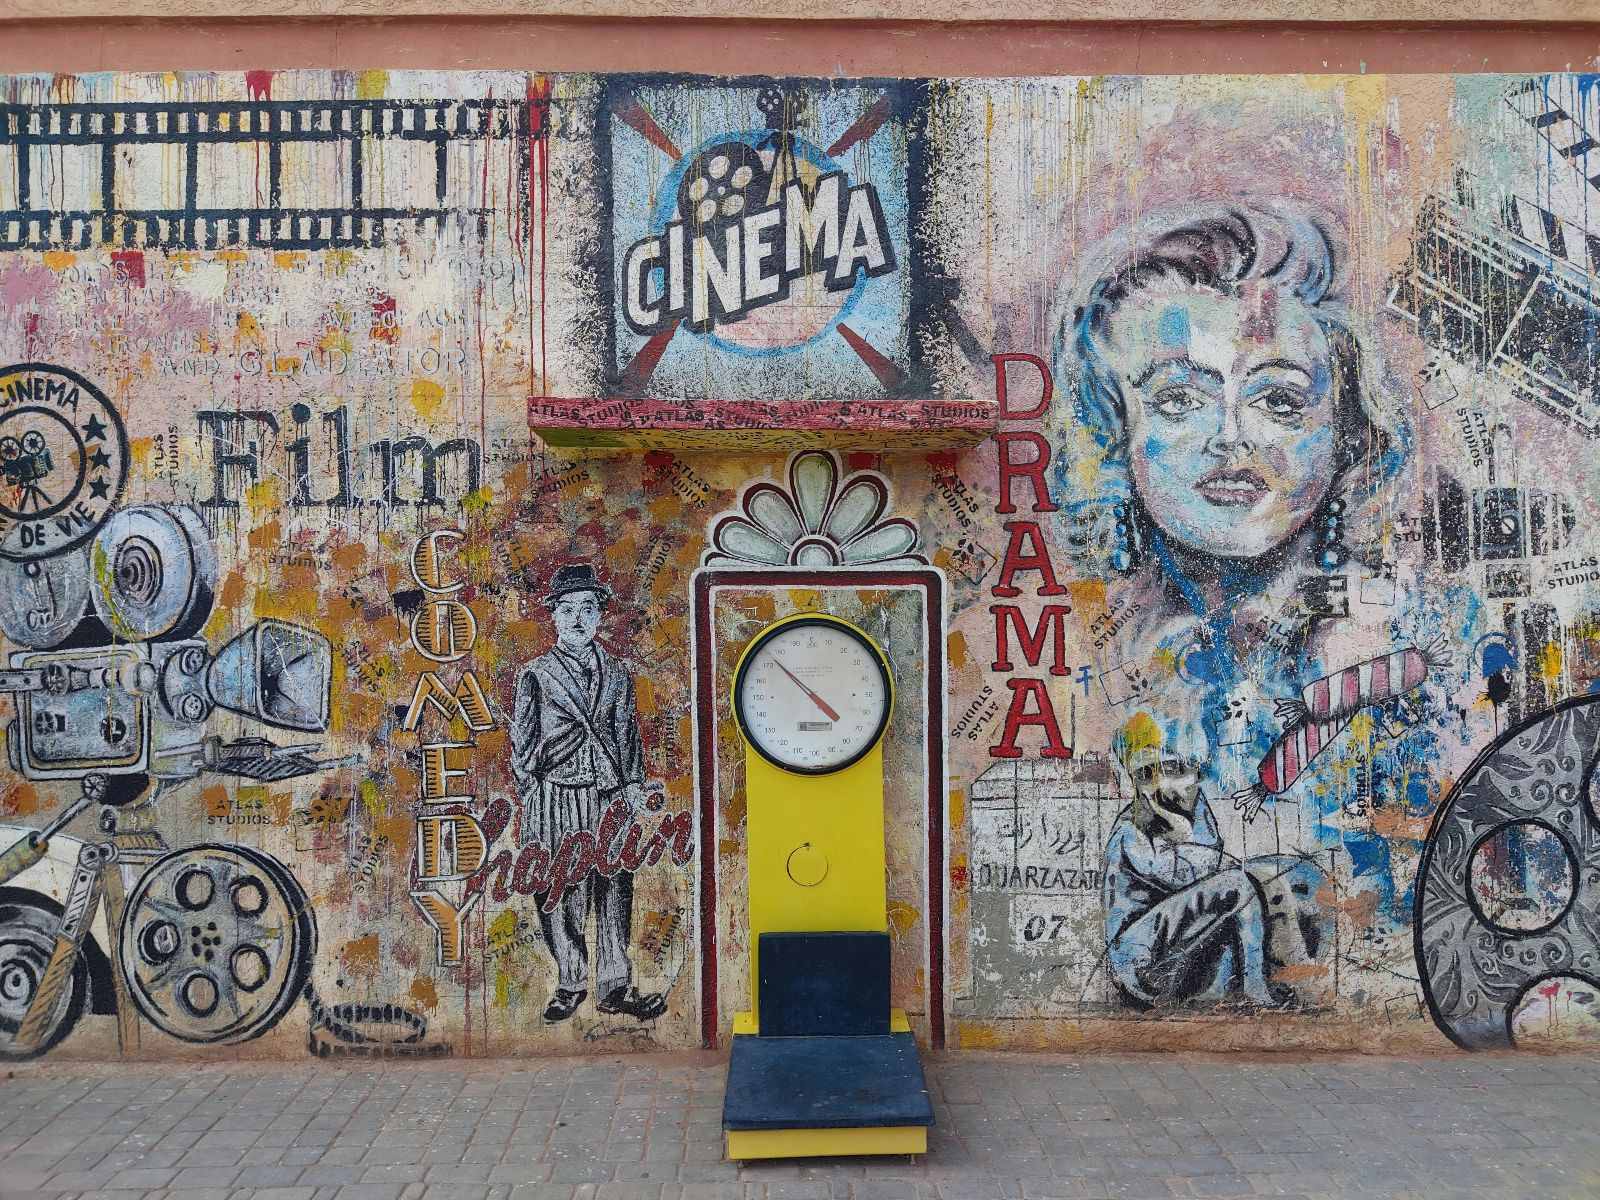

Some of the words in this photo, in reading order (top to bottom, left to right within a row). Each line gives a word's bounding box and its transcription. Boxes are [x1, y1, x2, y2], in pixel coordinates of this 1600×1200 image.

[624, 171, 894, 331] CINEMA
[154, 433, 164, 480] ATLAS
[168, 425, 180, 487] STUDIOS
[196, 403, 482, 508] Film
[1456, 408, 1483, 468] STUDIOS
[1473, 411, 1495, 455] ATLAS
[673, 460, 711, 493] ATLAS
[20, 523, 46, 549] DE
[55, 501, 96, 538] VIE
[990, 353, 1074, 759] DRAMA
[1553, 556, 1598, 574] ATLAS
[1090, 597, 1125, 635] ATLAS
[1094, 603, 1141, 650] STUDIOS
[951, 685, 993, 739] STUDIOS
[968, 700, 999, 741] ATLAS
[402, 529, 496, 968] COMEDY
[207, 814, 271, 825] STUDIOS
[216, 799, 263, 810] ATLAS
[354, 834, 389, 894] STUDIOS
[1024, 914, 1068, 941] 07
